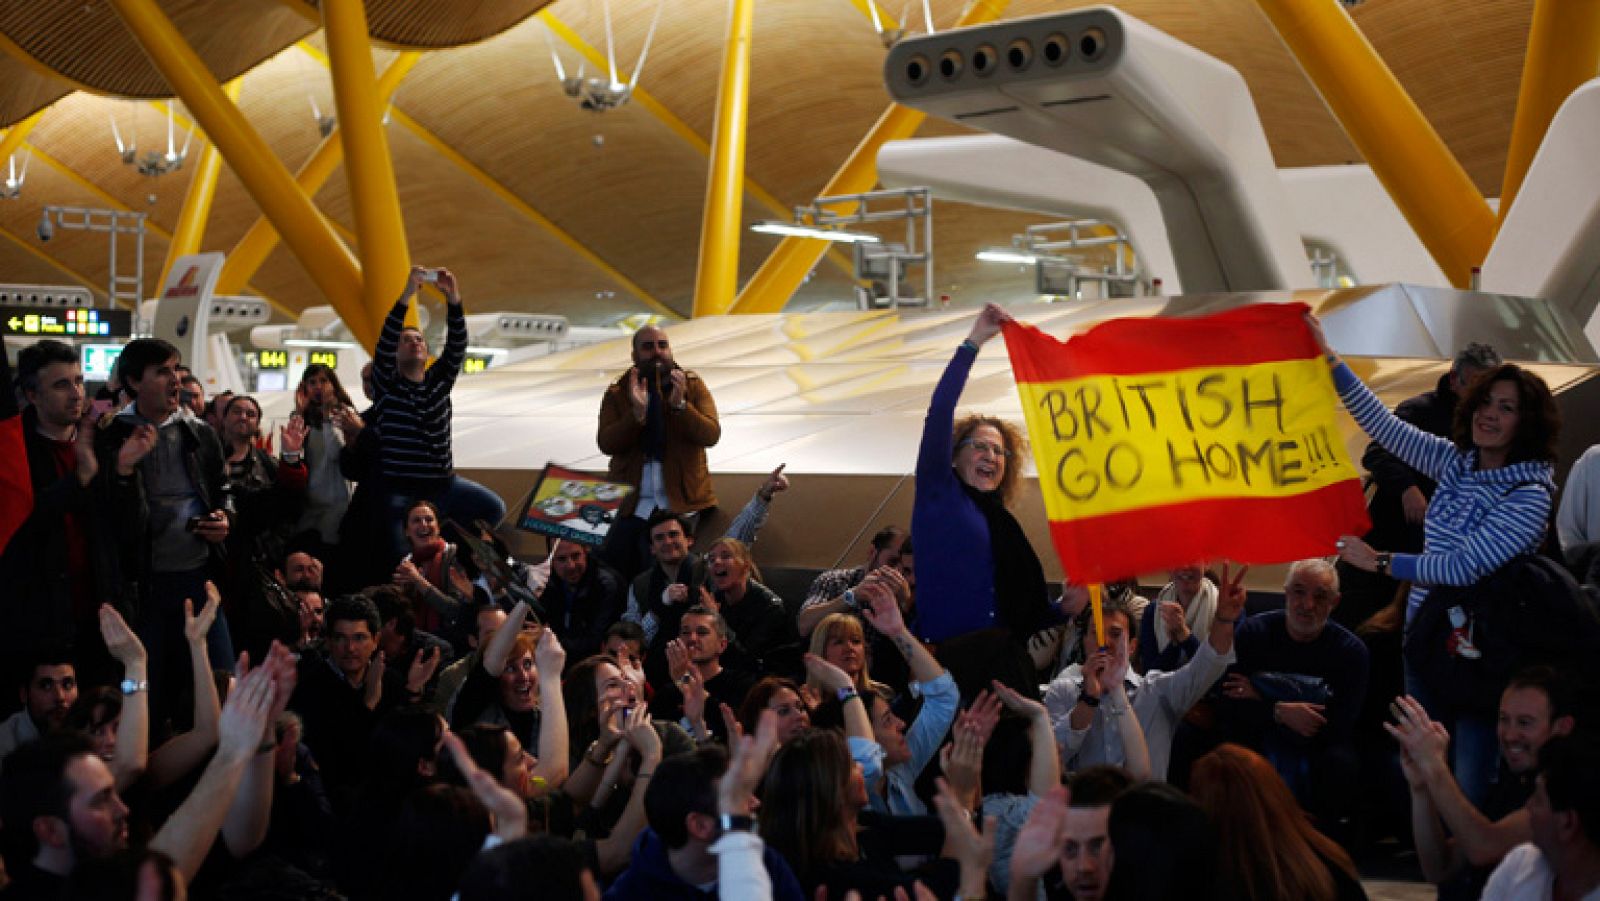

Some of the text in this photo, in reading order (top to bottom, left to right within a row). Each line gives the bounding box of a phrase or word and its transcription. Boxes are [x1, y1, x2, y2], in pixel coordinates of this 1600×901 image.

[1039, 372, 1284, 441] BRITISH
[1057, 425, 1339, 502] GO HOME!!!
